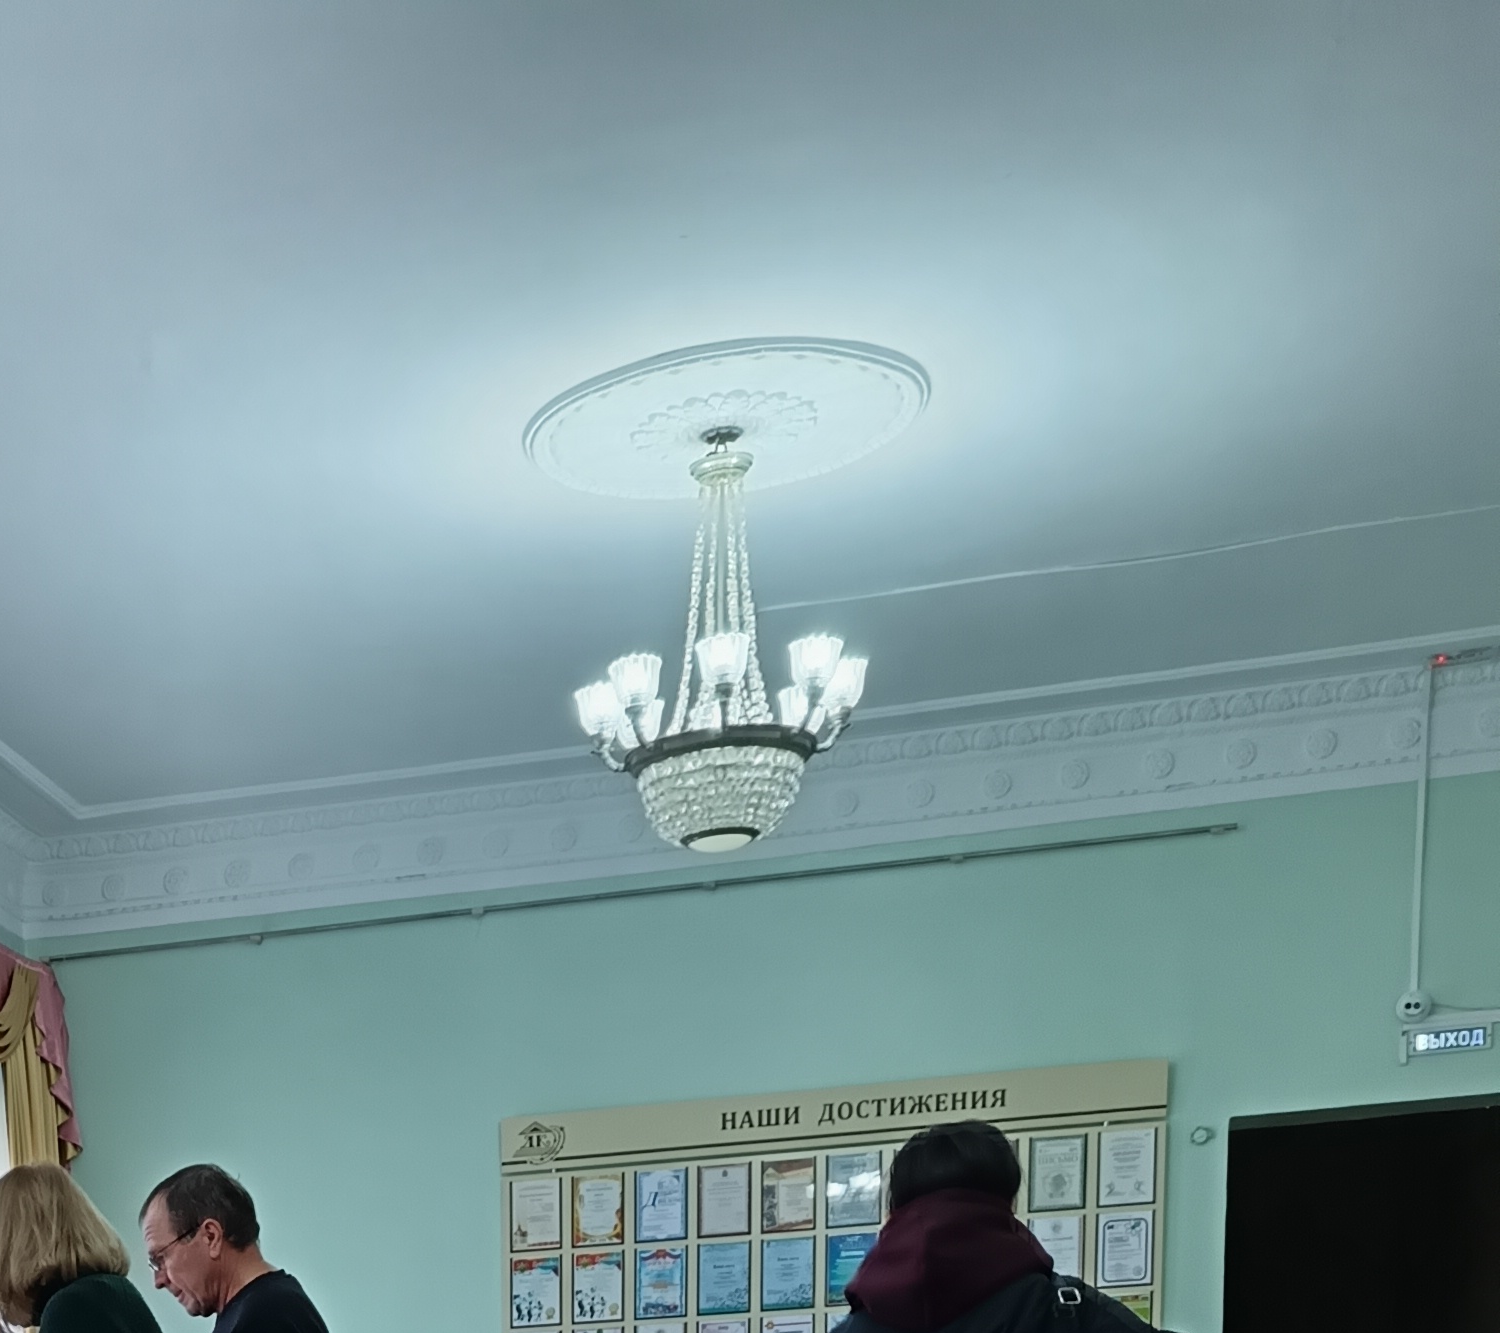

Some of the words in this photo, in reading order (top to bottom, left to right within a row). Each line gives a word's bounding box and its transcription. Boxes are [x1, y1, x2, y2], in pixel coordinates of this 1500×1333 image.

[1415, 1029, 1484, 1051] ВЫХОД
[720, 1106, 801, 1131] НАШИ
[818, 1088, 1007, 1126] ДОСТИЖЕНИЯ
